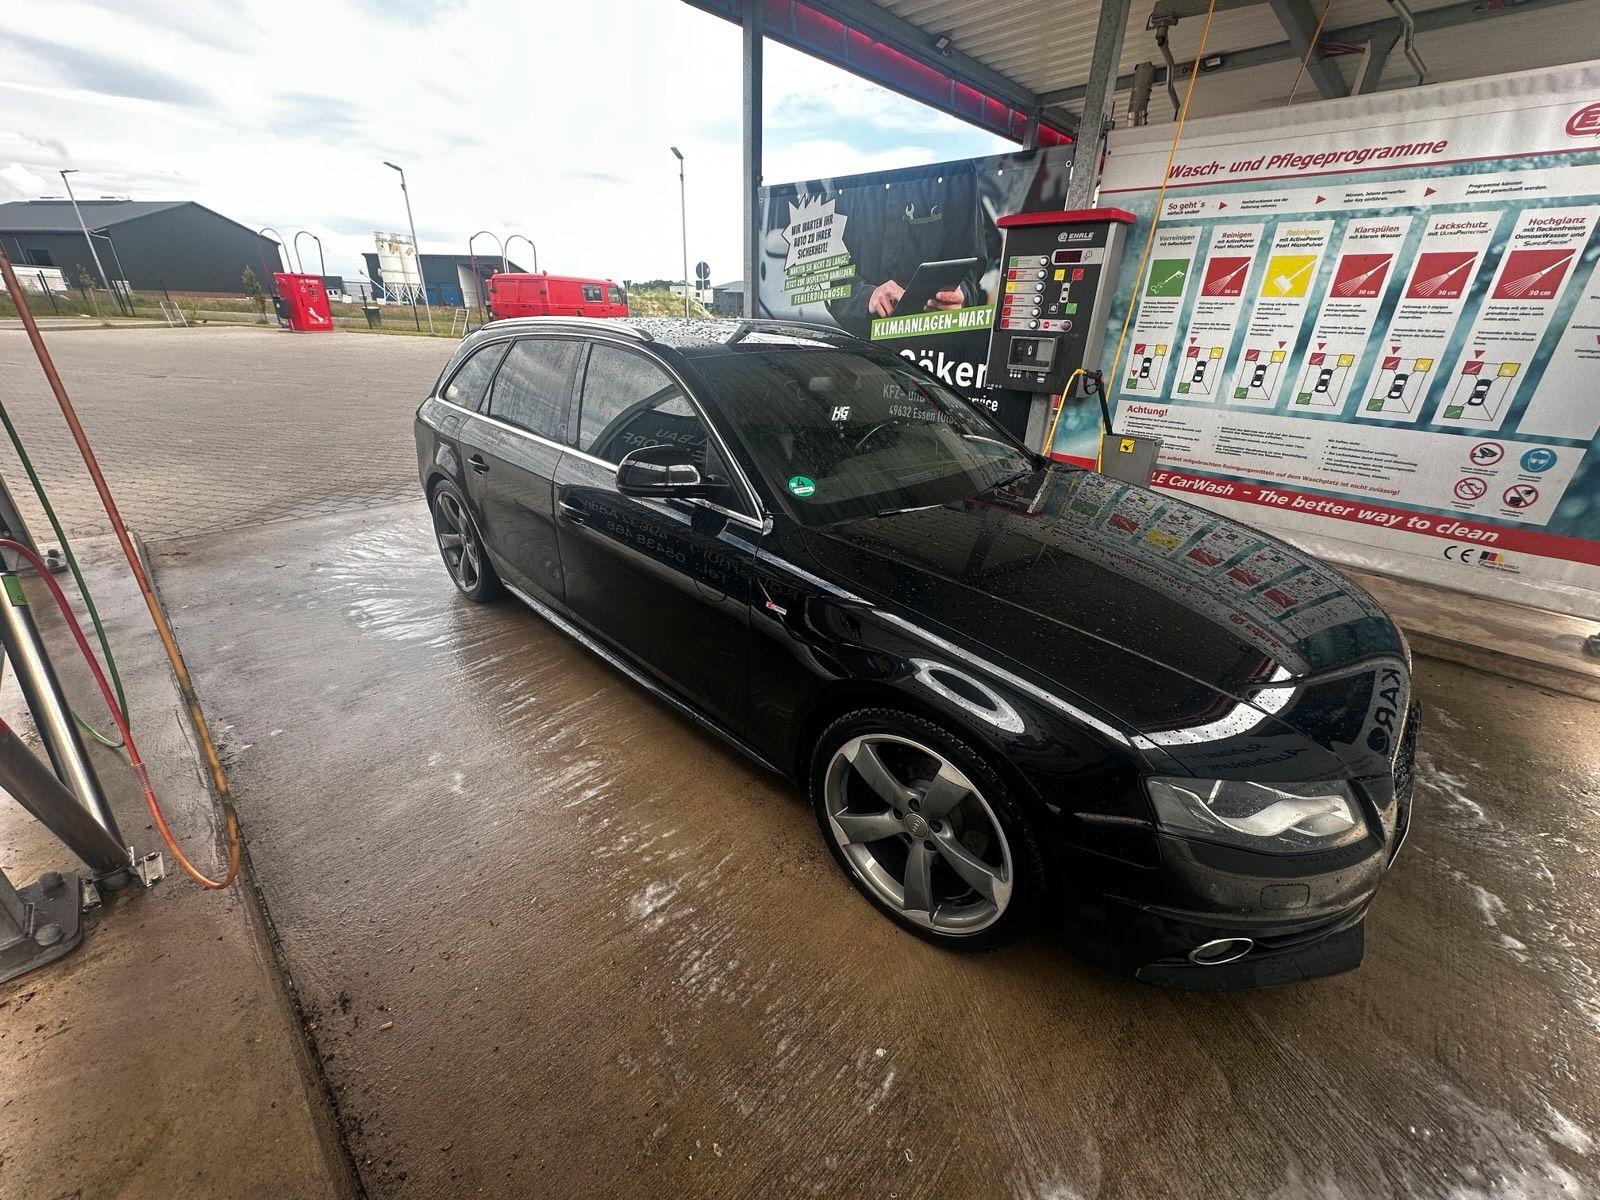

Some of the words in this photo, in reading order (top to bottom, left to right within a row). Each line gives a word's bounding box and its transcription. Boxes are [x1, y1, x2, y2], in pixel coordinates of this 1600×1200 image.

[1168, 161, 1225, 179] Wasch-
[1229, 156, 1264, 173] und
[1266, 140, 1448, 171] Pflegeprogramme
[792, 224, 801, 235] WIR
[802, 217, 822, 232] WARTEN
[824, 214, 834, 226] IHR
[1434, 221, 1488, 230] Lackschutz
[1528, 216, 1587, 227] Hochglanz
[794, 234, 806, 247] AUTO
[807, 232, 815, 243] ZU
[816, 228, 832, 241] IHRER
[1222, 231, 1253, 239] Reinigen
[1286, 228, 1320, 237] Reinigen
[1354, 225, 1400, 235] Klarspülen
[1159, 234, 1195, 243] Vorreinigen
[797, 242, 829, 259] SICHERHEIT!
[794, 287, 846, 304] FEHLERDIAGNOSE.
[913, 407, 936, 422] Essen
[1126, 405, 1168, 417] Achtung!
[1183, 459, 1221, 468] mitgebrachten
[1222, 461, 1275, 477] Reinigungsmitteln
[1302, 476, 1339, 487] Waschplatz
[1350, 483, 1368, 491] nicht
[1368, 487, 1400, 496] zulässig!
[1168, 475, 1235, 496] CarWash
[1257, 490, 1287, 506] The
[1292, 495, 1355, 516] better
[1357, 508, 1403, 526] way
[1406, 516, 1431, 530] to
[1436, 519, 1500, 543] clean
